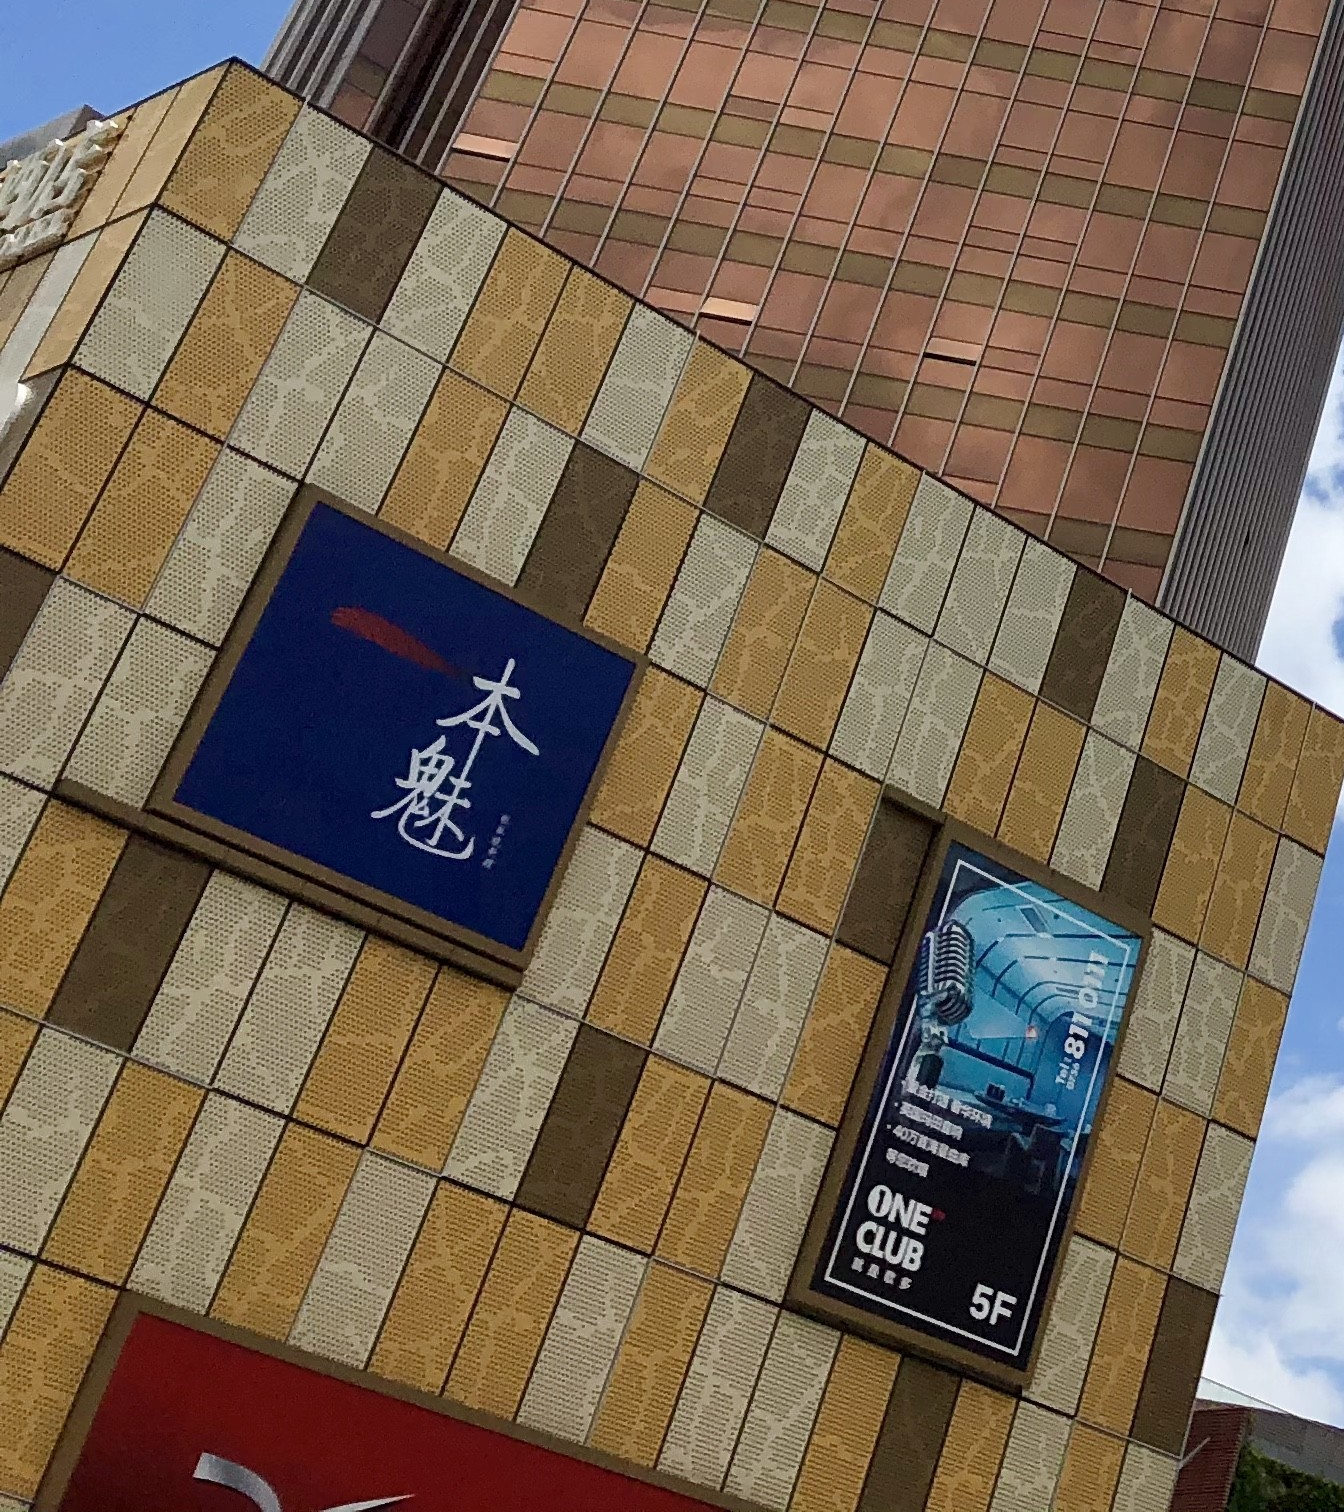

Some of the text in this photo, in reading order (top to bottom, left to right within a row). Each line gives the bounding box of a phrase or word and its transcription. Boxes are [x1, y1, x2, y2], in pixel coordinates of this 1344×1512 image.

[867, 1184, 934, 1236] ONE
[855, 1220, 925, 1272] CLUB
[969, 1282, 1018, 1326] 5F
